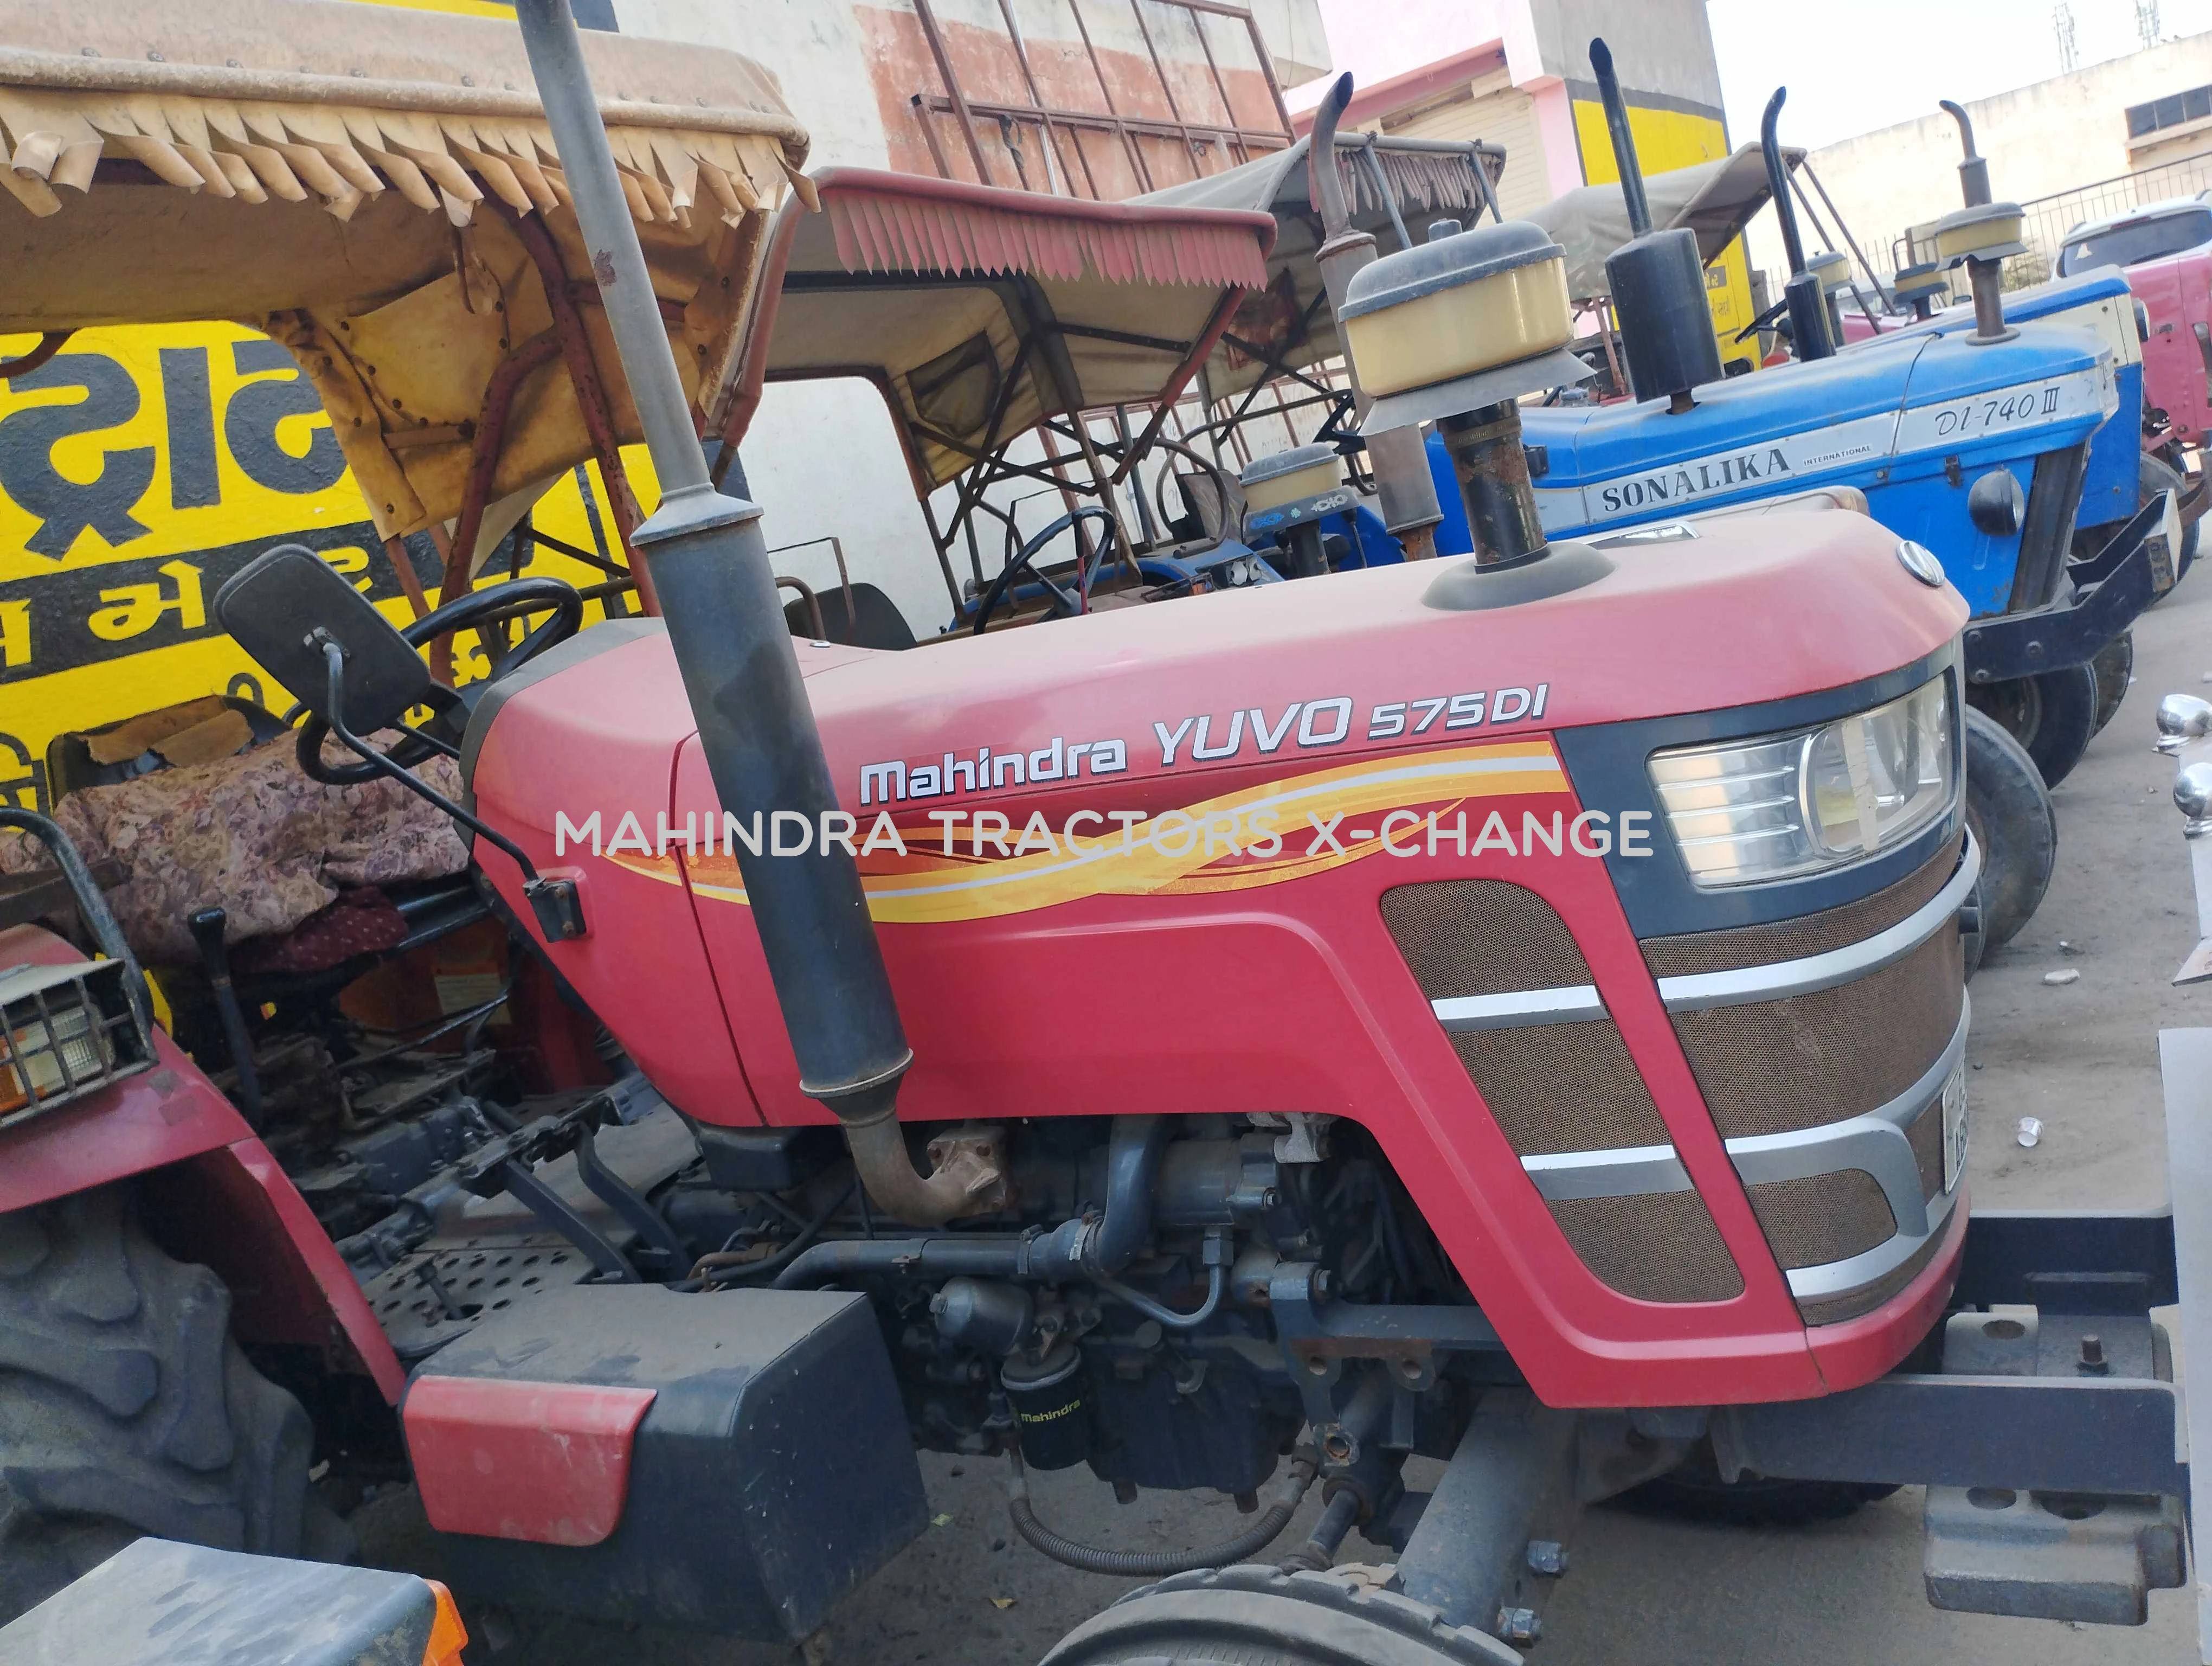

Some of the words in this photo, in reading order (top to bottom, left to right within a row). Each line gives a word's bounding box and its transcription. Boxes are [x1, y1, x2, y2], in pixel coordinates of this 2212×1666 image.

[1934, 393, 2035, 436] DI-740
[2040, 386, 2061, 415] III
[1601, 447, 1792, 514] SONALIKA
[1803, 445, 1872, 467] INTERNATIONAL
[860, 736, 1129, 807] Mahindra
[1153, 696, 1353, 767] YUVO
[1367, 683, 1549, 741] 575DI
[1020, 1399, 1081, 1423] Mahindra
